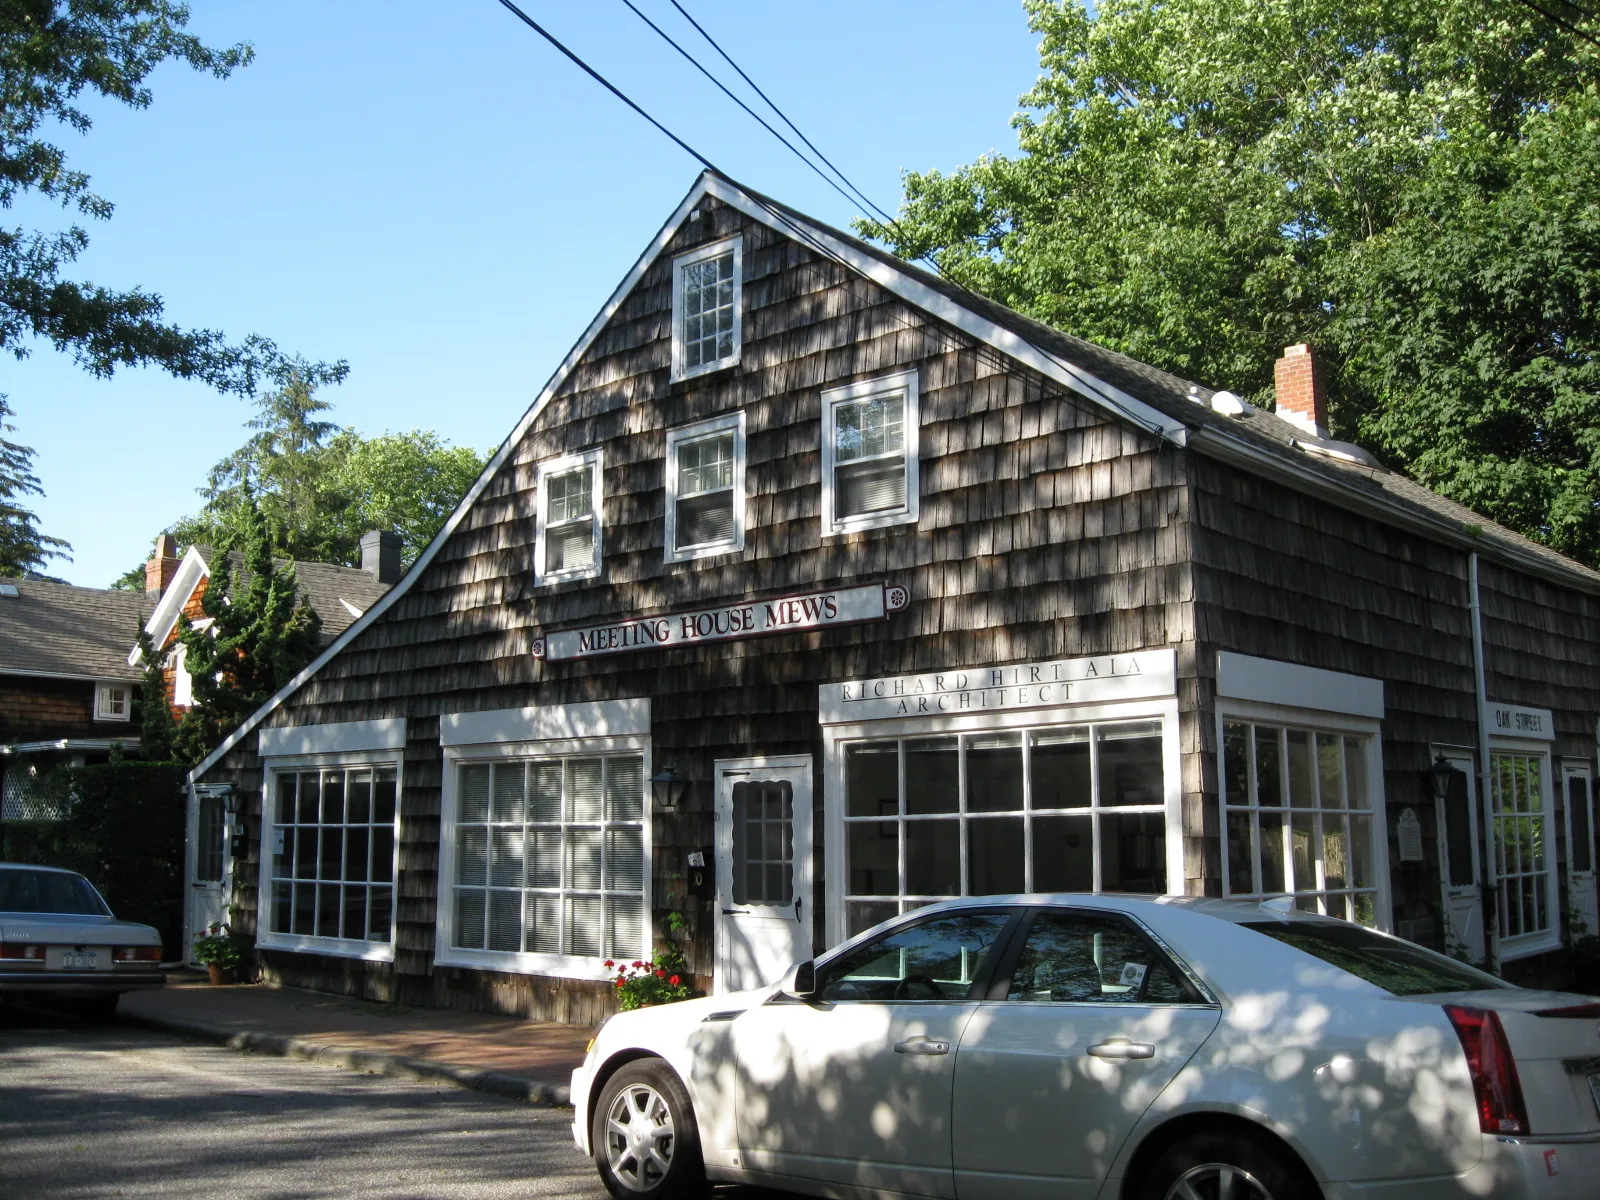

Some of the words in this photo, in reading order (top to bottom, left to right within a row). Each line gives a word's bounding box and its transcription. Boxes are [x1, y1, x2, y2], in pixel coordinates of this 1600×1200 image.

[578, 619, 671, 653] MEETING
[680, 608, 755, 639] HOUSE
[764, 595, 838, 628] MEWS
[842, 673, 968, 699] RICHARD
[991, 664, 1063, 686] HIRT
[1085, 657, 1142, 677] AIA
[897, 684, 1075, 714] ARCHITECT
[1495, 709, 1511, 728] OAK
